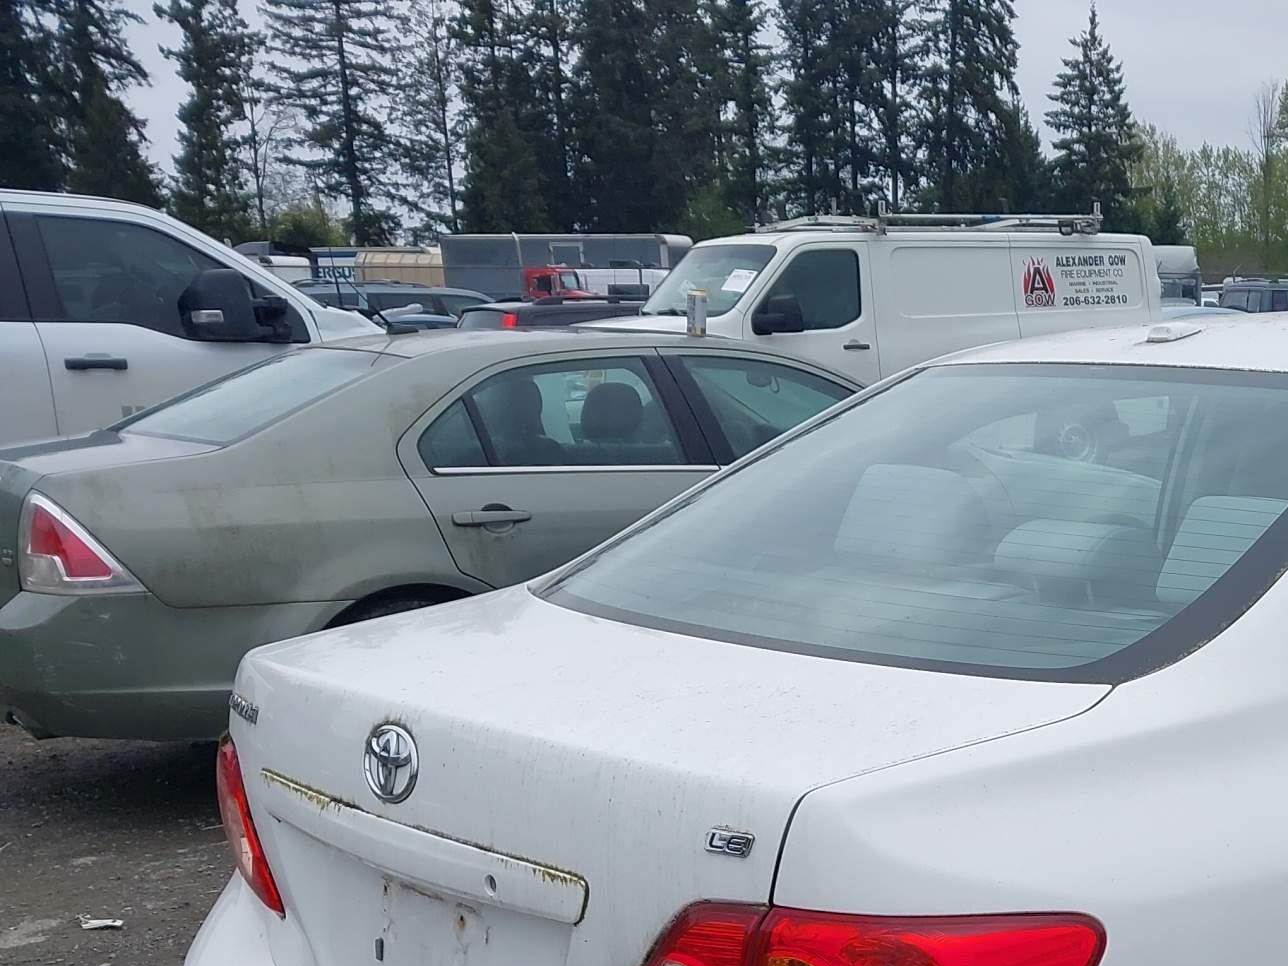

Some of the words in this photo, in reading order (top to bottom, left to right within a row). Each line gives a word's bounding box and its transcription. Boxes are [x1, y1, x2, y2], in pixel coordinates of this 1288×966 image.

[1055, 254, 1105, 268] ALEXANDER
[1109, 254, 1126, 266] GOW
[1029, 266, 1049, 294] A
[1061, 269, 1075, 279] FIRE
[1076, 268, 1111, 279] EQUIPMENT
[1025, 293, 1056, 307] GOW
[1063, 294, 1128, 306] 206-632-2810
[704, 829, 756, 858] LE
